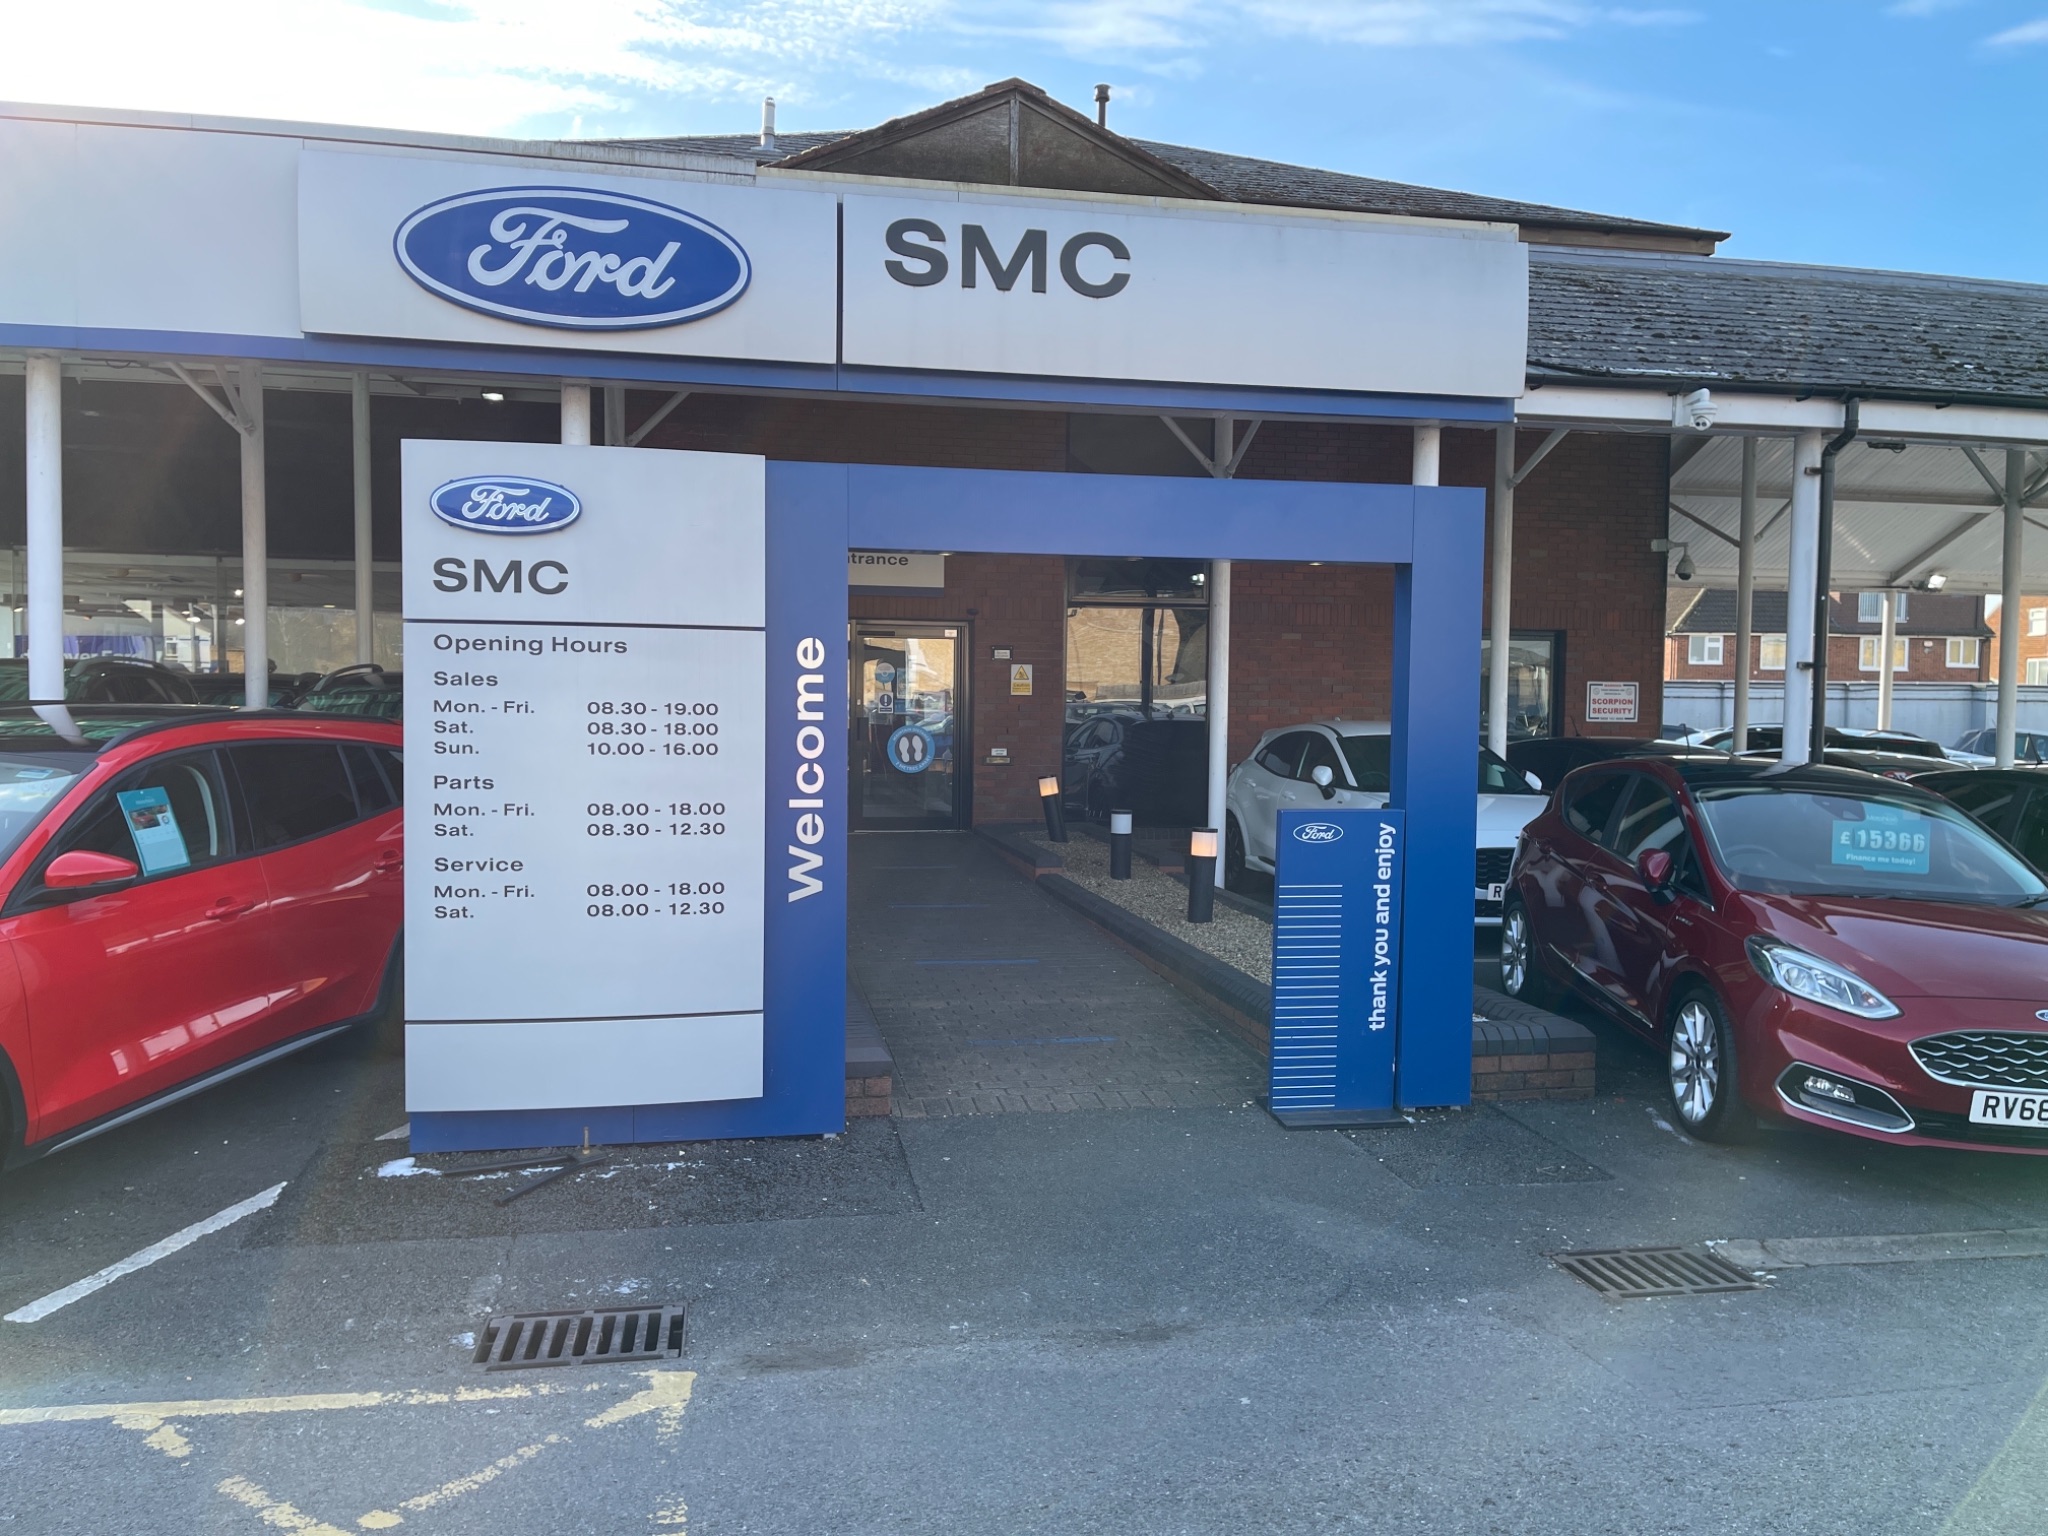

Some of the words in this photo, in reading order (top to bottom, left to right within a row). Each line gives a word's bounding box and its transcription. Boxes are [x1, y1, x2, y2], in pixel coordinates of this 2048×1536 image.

[467, 206, 682, 299] Ford
[884, 218, 1131, 299] SMC
[461, 484, 552, 522] Ford
[847, 552, 909, 566] trance
[432, 557, 569, 595] SMC
[433, 633, 543, 656] Opening
[551, 636, 628, 654] Hours
[433, 670, 499, 687] Sales
[433, 700, 486, 714] Mon.
[503, 700, 535, 714] Fri.
[587, 702, 647, 716] 08.30
[663, 702, 719, 716] 19.00
[433, 720, 474, 734] Sat.
[587, 722, 647, 736] 08.30
[663, 722, 719, 736] 18.00
[433, 741, 480, 755] Sun.
[587, 742, 647, 756] 10.00
[663, 742, 719, 756] 16.00
[787, 636, 825, 903] Welcome
[433, 774, 495, 790] Parts
[433, 803, 486, 817] Mon.
[503, 803, 535, 817] Fri.
[586, 803, 650, 817] 08.00
[668, 803, 726, 817] 18.00
[433, 823, 474, 837] Sat.
[586, 823, 650, 837] 08.30
[668, 823, 726, 837] 12.30
[1301, 825, 1335, 840] Ford
[1374, 822, 1397, 880] enjoy
[433, 857, 525, 872] Service
[1845, 853, 1877, 863] Finance
[1890, 857, 1917, 866] today!
[433, 885, 486, 899] Mon.
[503, 885, 535, 899] Fri.
[586, 883, 650, 897] 08.00
[668, 883, 726, 897] 18.00
[433, 905, 474, 919] Sat.
[586, 903, 650, 917] 08.00
[668, 903, 726, 917] 12.30
[1372, 884, 1391, 925] and
[1374, 928, 1391, 967] you
[1367, 969, 1388, 1031] thank
